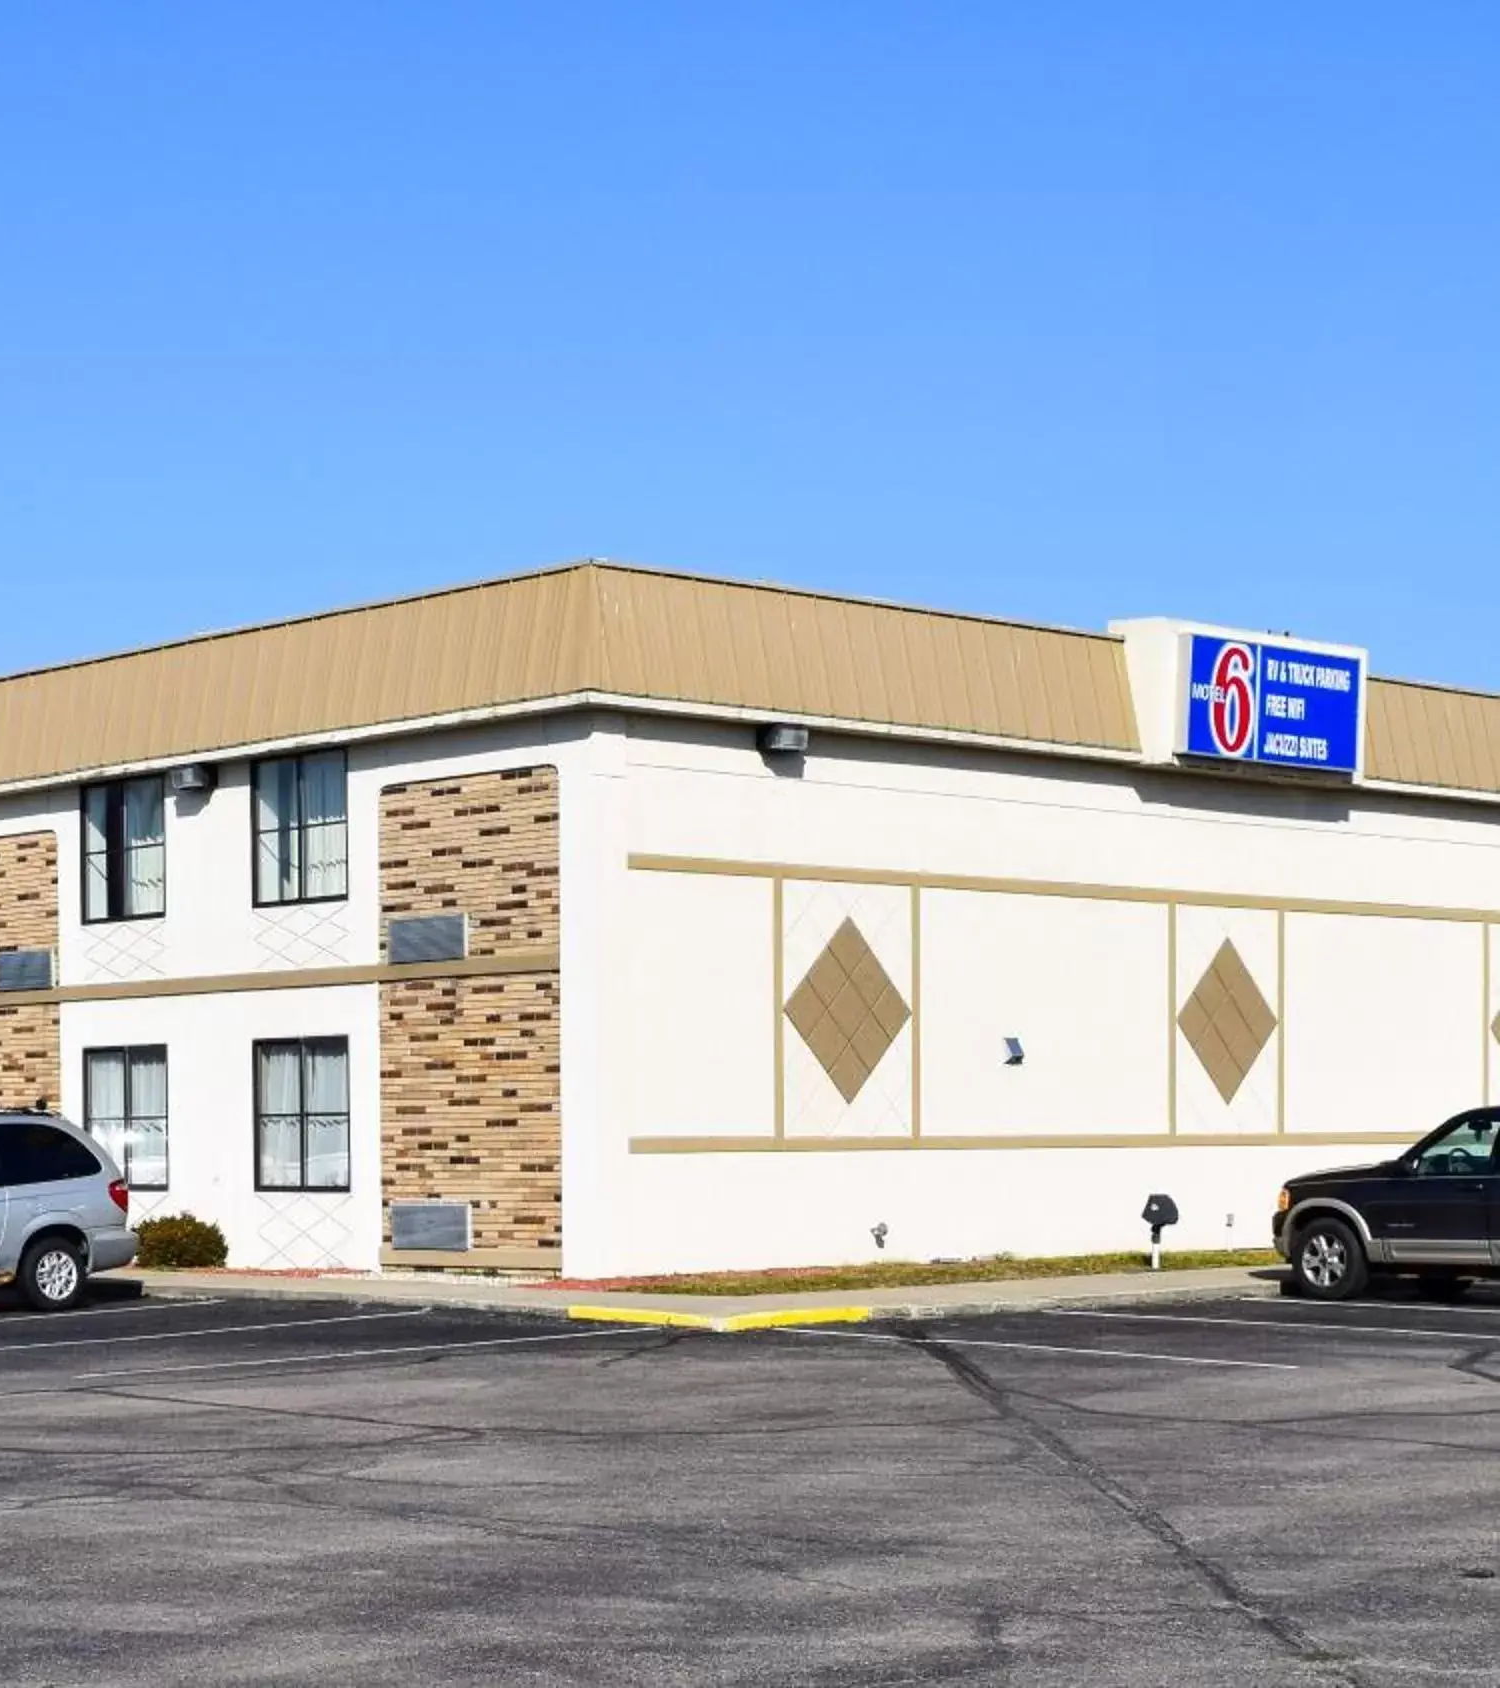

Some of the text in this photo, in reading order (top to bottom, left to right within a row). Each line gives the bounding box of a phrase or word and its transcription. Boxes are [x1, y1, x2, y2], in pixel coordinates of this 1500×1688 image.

[1267, 658, 1350, 692] RV & TRUCK PARKING
[1191, 643, 1253, 756] MOTEL 6
[1266, 694, 1286, 718] FREE
[1299, 736, 1328, 761] SUITES
